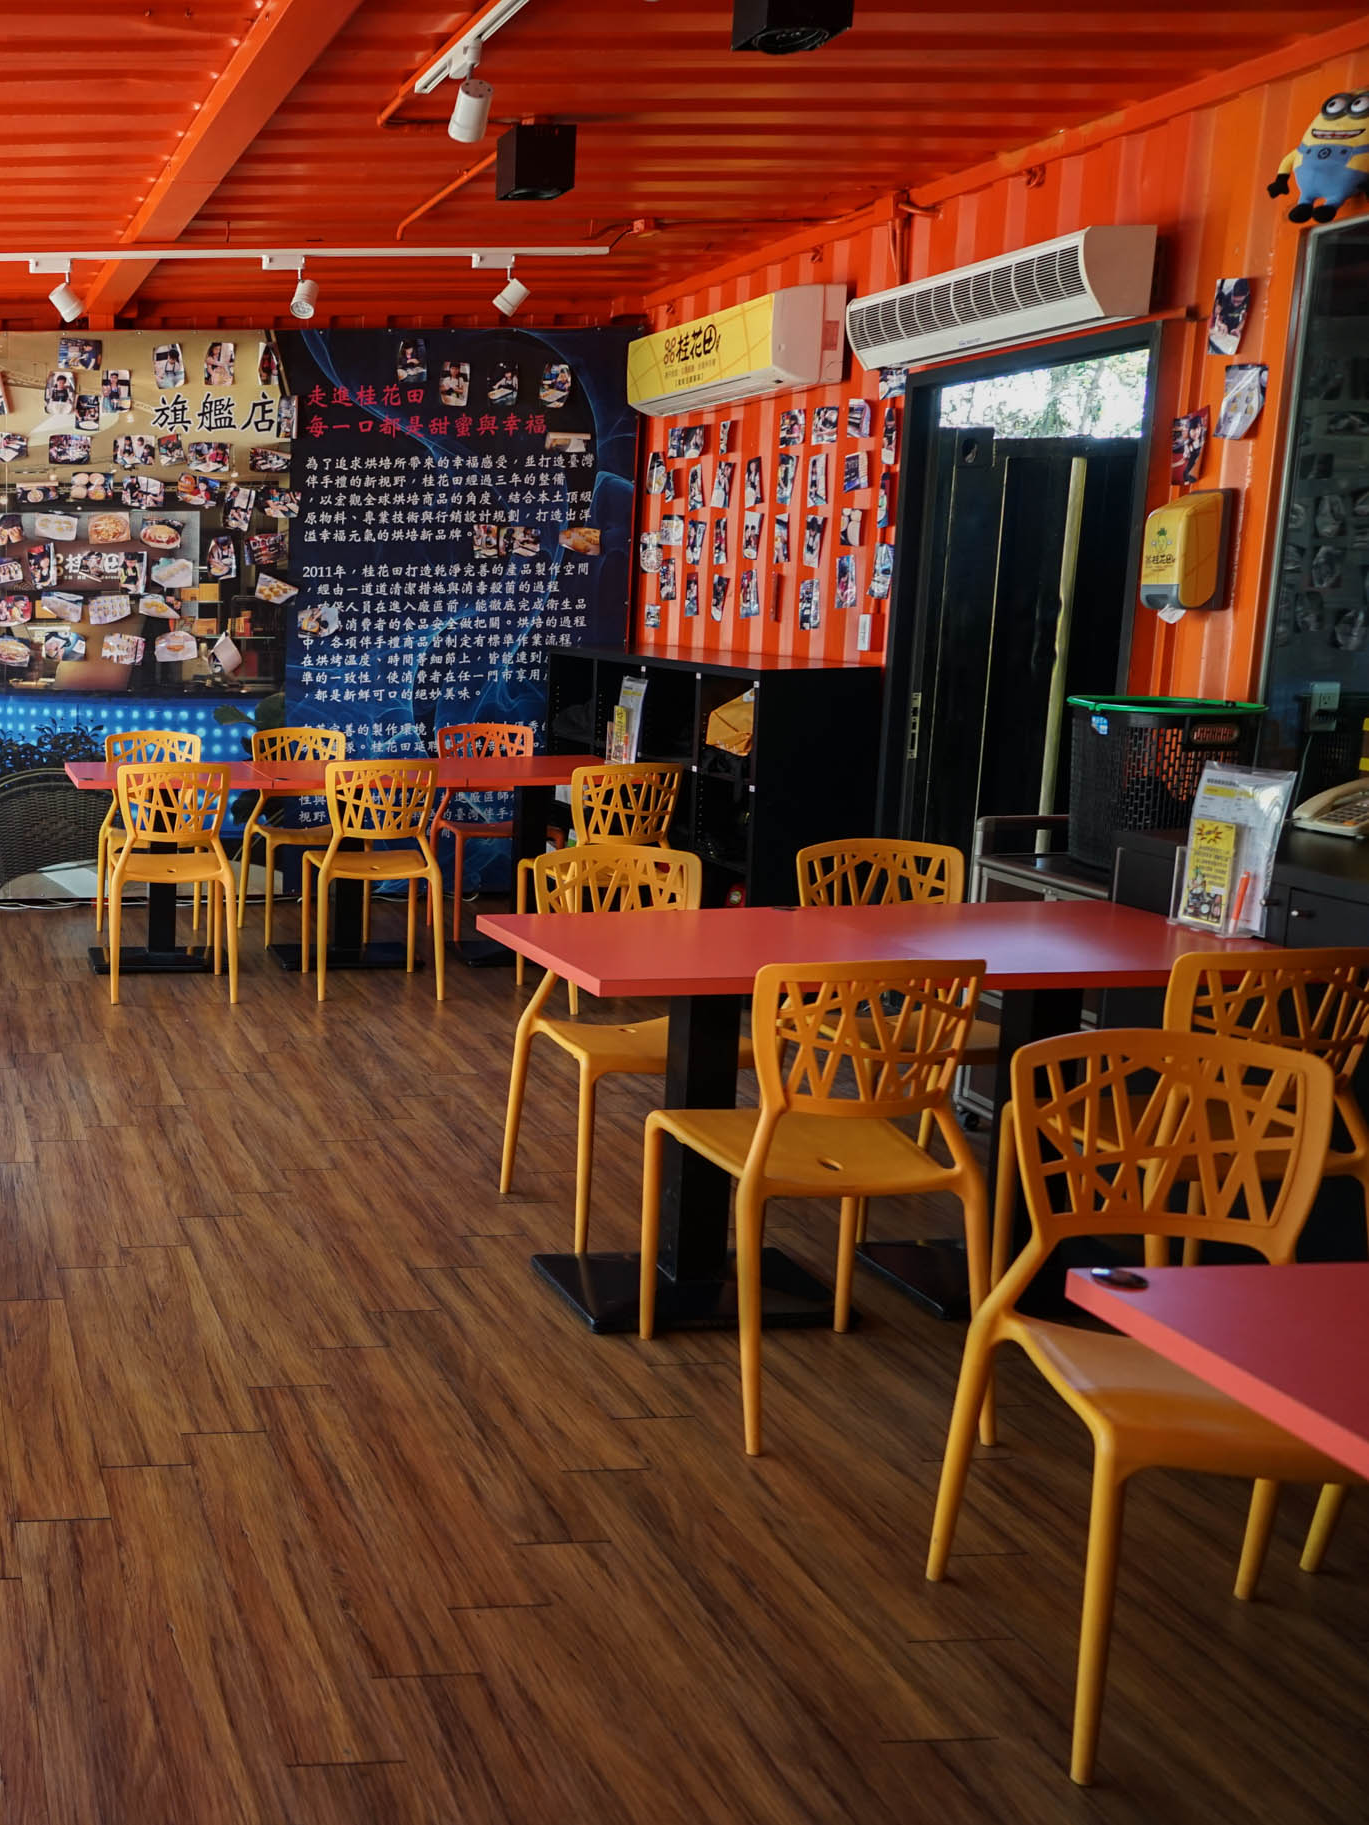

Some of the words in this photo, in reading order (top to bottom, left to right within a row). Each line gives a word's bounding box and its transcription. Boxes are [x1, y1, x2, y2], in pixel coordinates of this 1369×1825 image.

[306, 384, 426, 408] 走進桂花田
[152, 391, 277, 433] 旗艦店
[305, 413, 548, 439] 每一口都是甜蜜與幸福
[300, 668, 549, 685] 準的一致性，使消費者在任一門市享用
